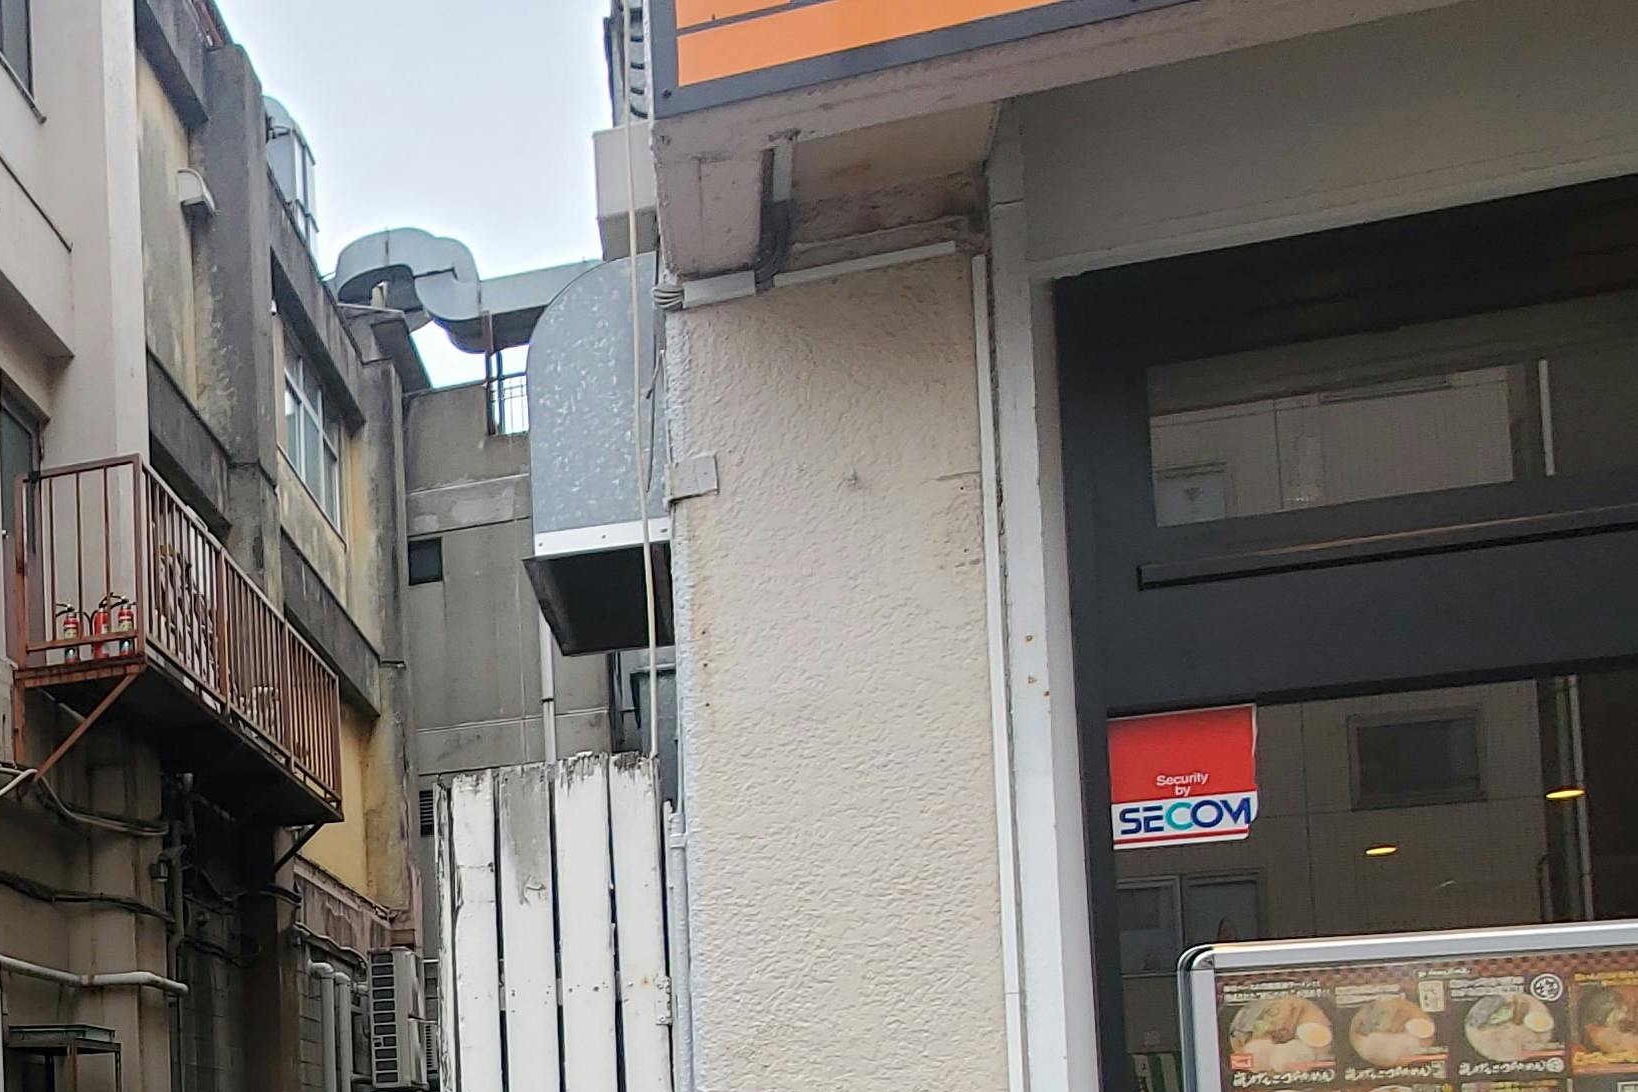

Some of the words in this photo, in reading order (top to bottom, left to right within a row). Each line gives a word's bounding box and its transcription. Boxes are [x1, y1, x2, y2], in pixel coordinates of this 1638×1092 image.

[1156, 772, 1209, 786] Security
[1174, 785, 1191, 797] by
[1119, 797, 1251, 835] SECOM
